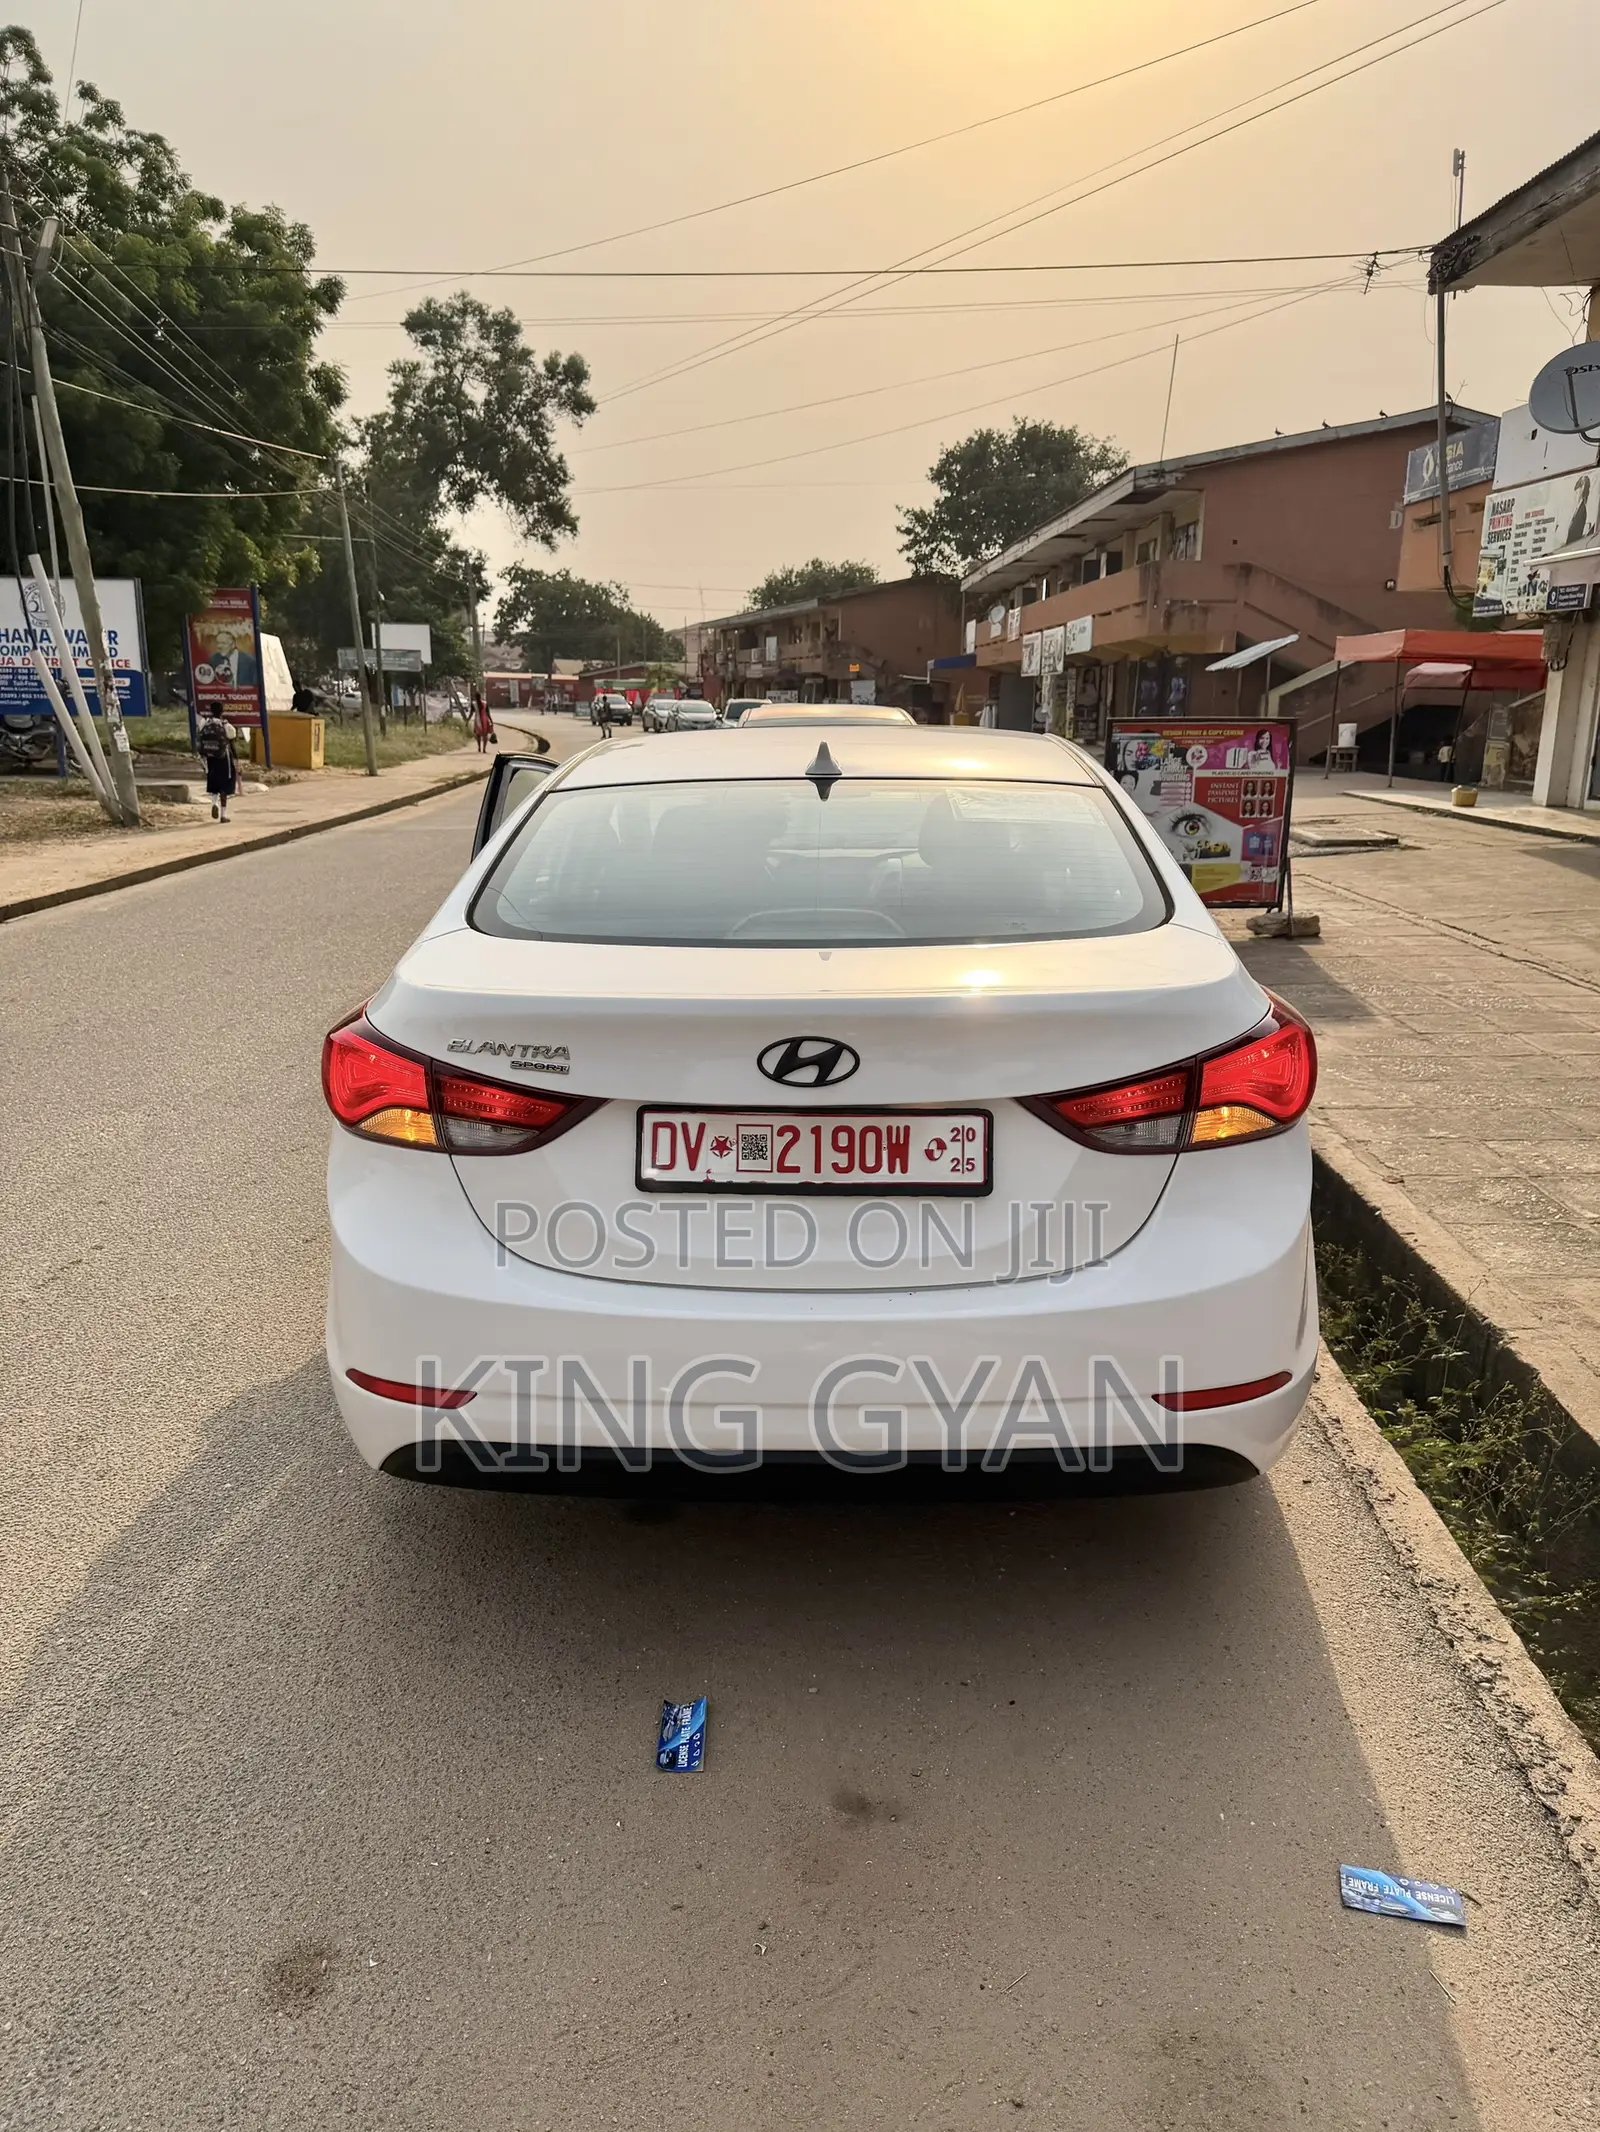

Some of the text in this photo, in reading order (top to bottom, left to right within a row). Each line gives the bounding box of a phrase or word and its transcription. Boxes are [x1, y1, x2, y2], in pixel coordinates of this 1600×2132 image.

[1489, 514, 1514, 531] PRINTING
[1487, 528, 1512, 544] SERVICES
[64, 629, 118, 645] WAR
[0, 645, 58, 657] OMPNY
[22, 657, 79, 667] DTRIT
[86, 659, 131, 668] OICE
[447, 1038, 571, 1060] ELANTRA
[510, 1060, 570, 1074] SPORT
[652, 1121, 911, 1174] DV 2190W
[1348, 1877, 1379, 1892] FRAME
[1383, 1884, 1412, 1899] PLATE
[1415, 1891, 1455, 1905] LICENSE
